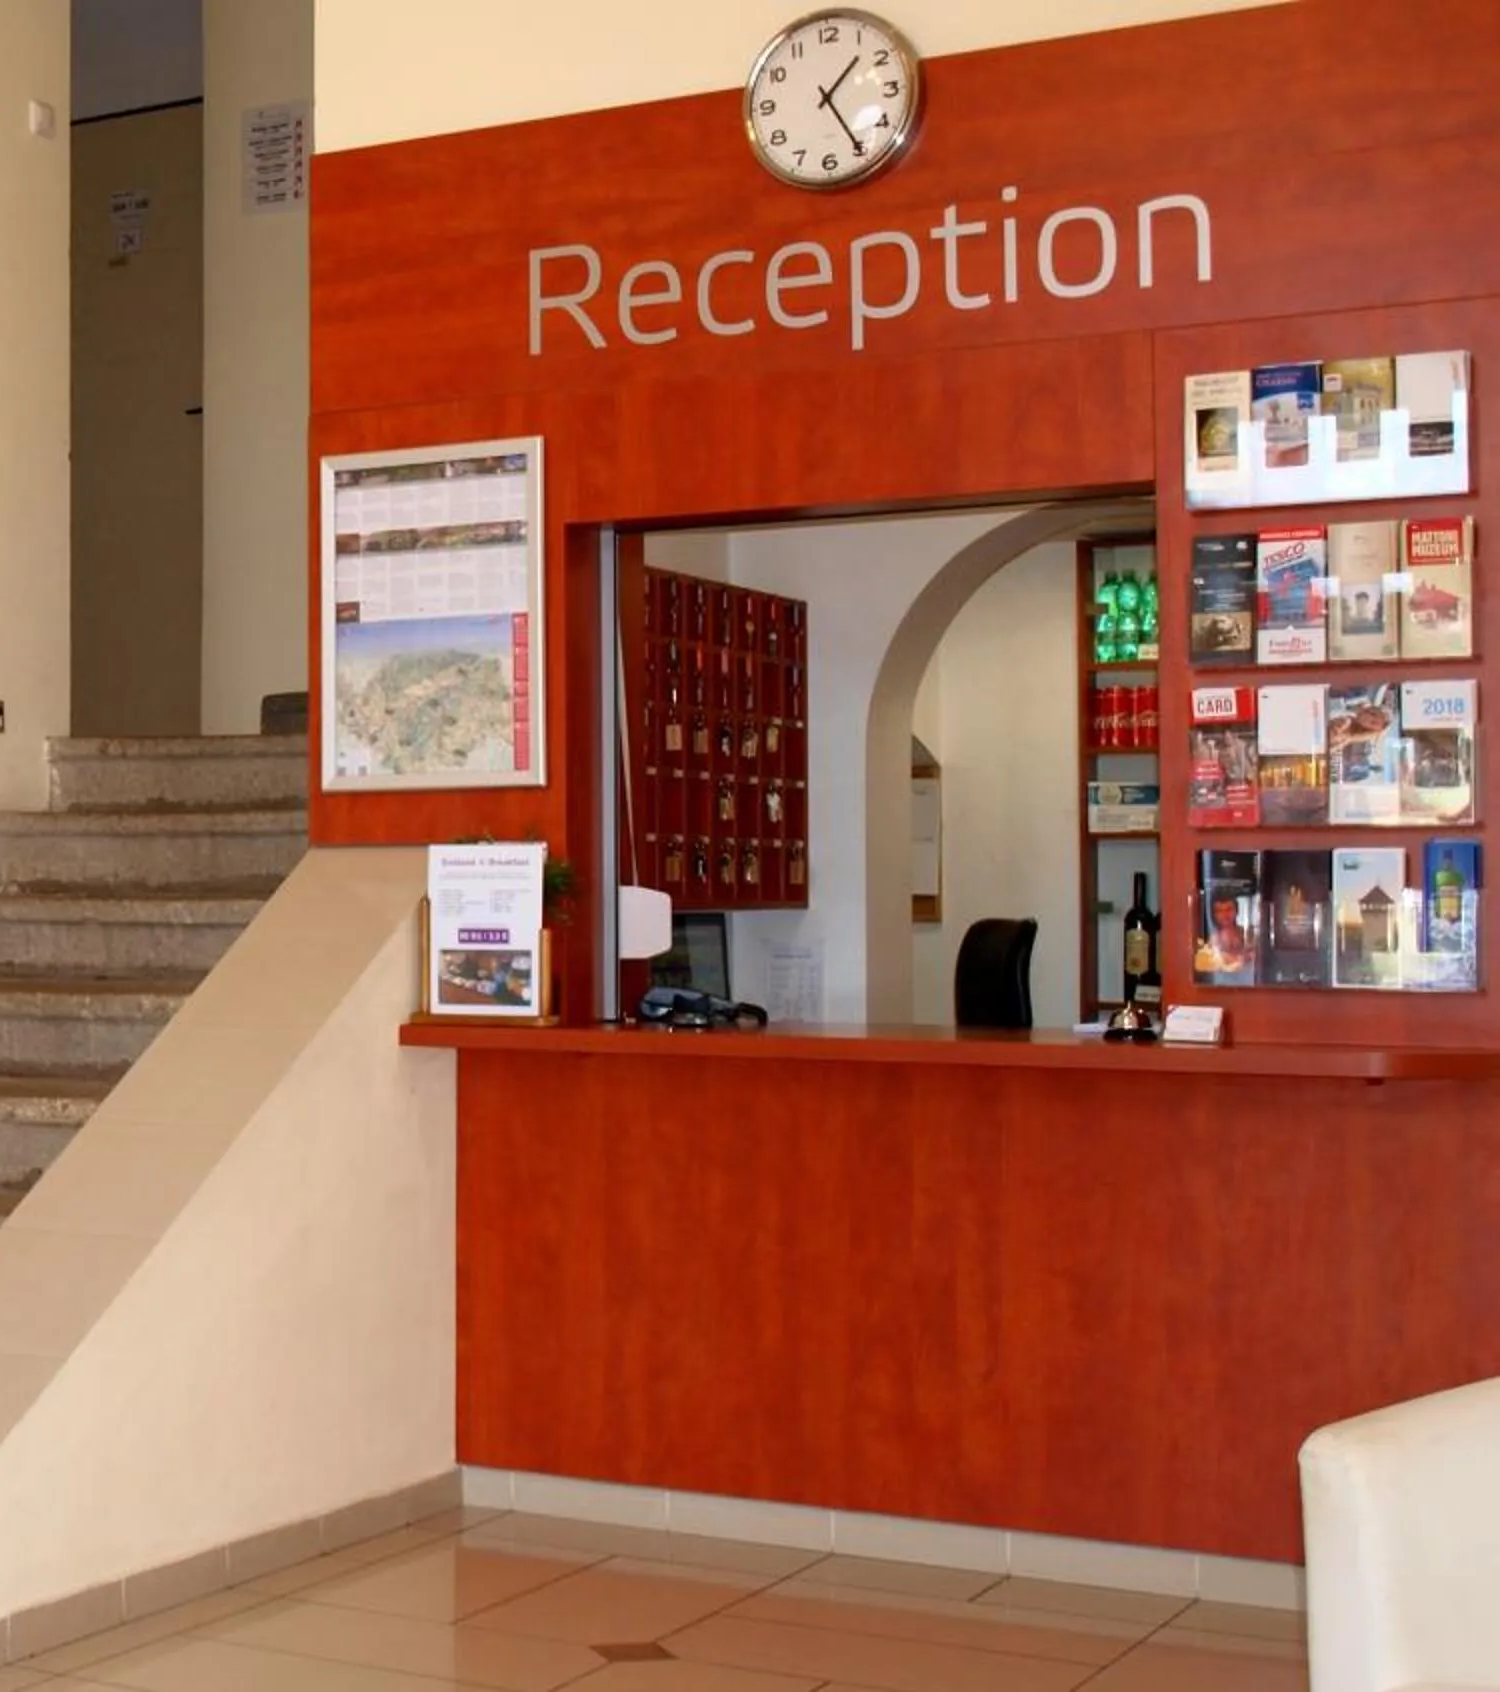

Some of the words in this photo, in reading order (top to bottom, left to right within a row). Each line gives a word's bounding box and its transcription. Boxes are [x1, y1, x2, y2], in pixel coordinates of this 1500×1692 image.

[819, 27, 840, 44] 12
[857, 30, 861, 45] 1
[791, 42, 803, 59] 11
[873, 50, 889, 67] 2
[769, 67, 787, 83] 10
[883, 81, 899, 98] 3
[759, 100, 776, 116] 9
[876, 113, 890, 129] 4
[770, 130, 787, 146] 8
[792, 150, 807, 167] 7
[821, 153, 839, 171] 6
[529, 187, 1211, 355] Reception
[1422, 698, 1465, 716] 2018
